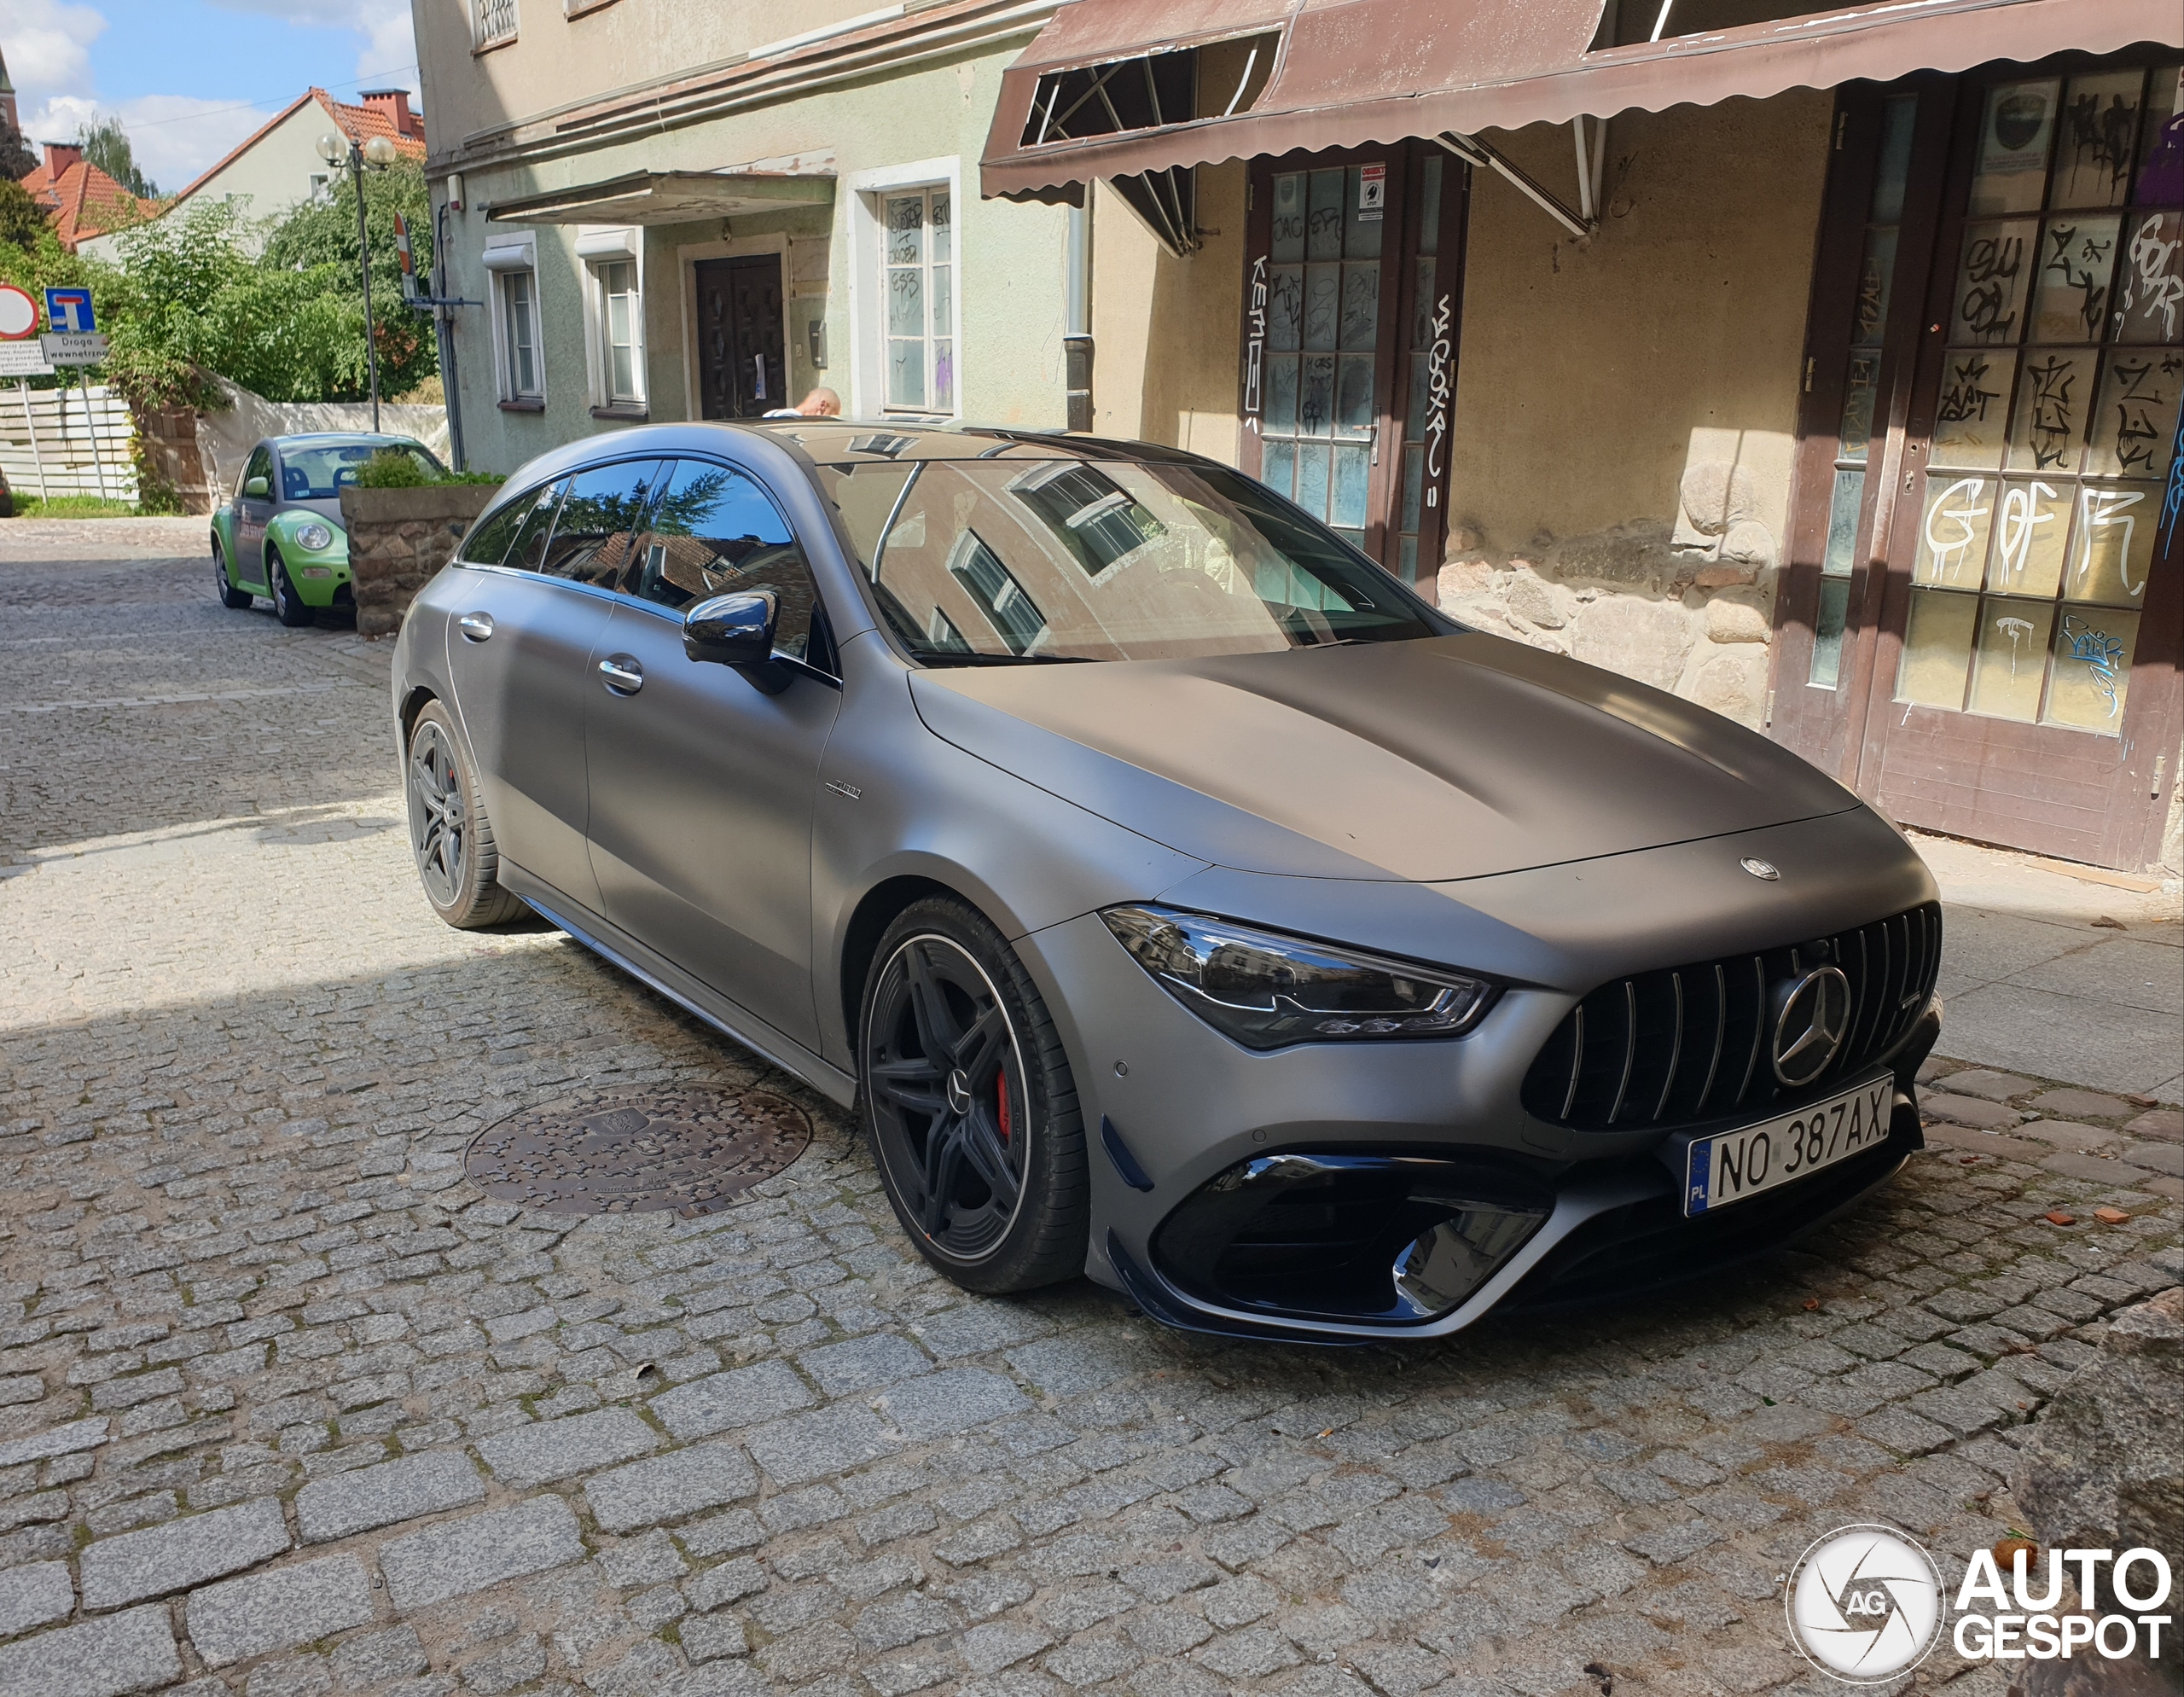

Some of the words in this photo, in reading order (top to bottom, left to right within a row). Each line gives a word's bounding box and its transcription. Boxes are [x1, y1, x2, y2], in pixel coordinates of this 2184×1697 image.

[61, 337, 93, 347] Droga
[835, 779, 862, 798] TURBO
[1718, 1131, 1770, 1199] NO
[1784, 1084, 1886, 1174] 387AX
[1691, 1185, 1705, 1202] PL
